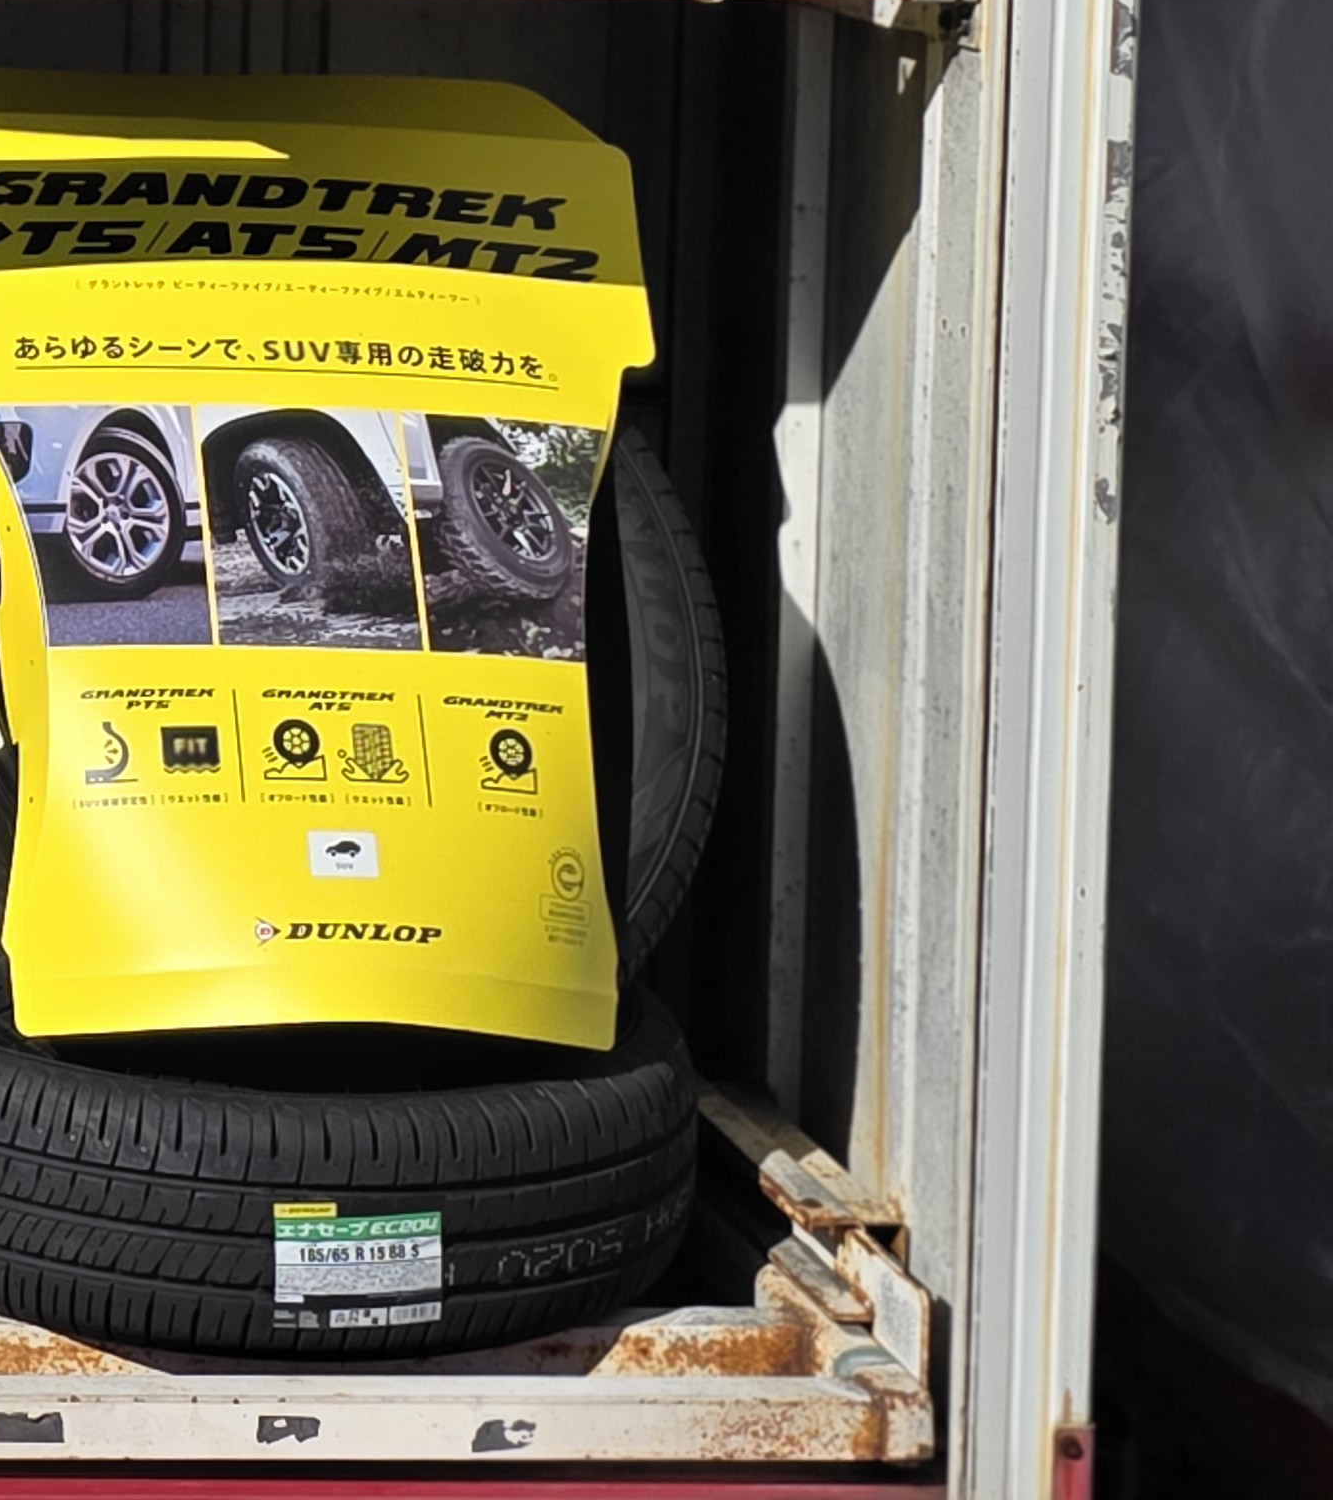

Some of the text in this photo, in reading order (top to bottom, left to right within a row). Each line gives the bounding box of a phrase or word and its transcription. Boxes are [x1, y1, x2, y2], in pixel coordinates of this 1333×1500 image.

[14, 335, 558, 382] あらゆるシーンで、SUV専用の走破力を。
[80, 688, 564, 714] GRANDTREK GRANDTREK GRANDTREK
[173, 738, 207, 755] FIT
[285, 922, 443, 944] DUNLOP
[276, 1217, 439, 1238] エナセーブ EC204
[299, 1247, 350, 1263] 185/65
[355, 1246, 365, 1261] R
[369, 1246, 386, 1260] 15
[411, 1244, 419, 1258] S
